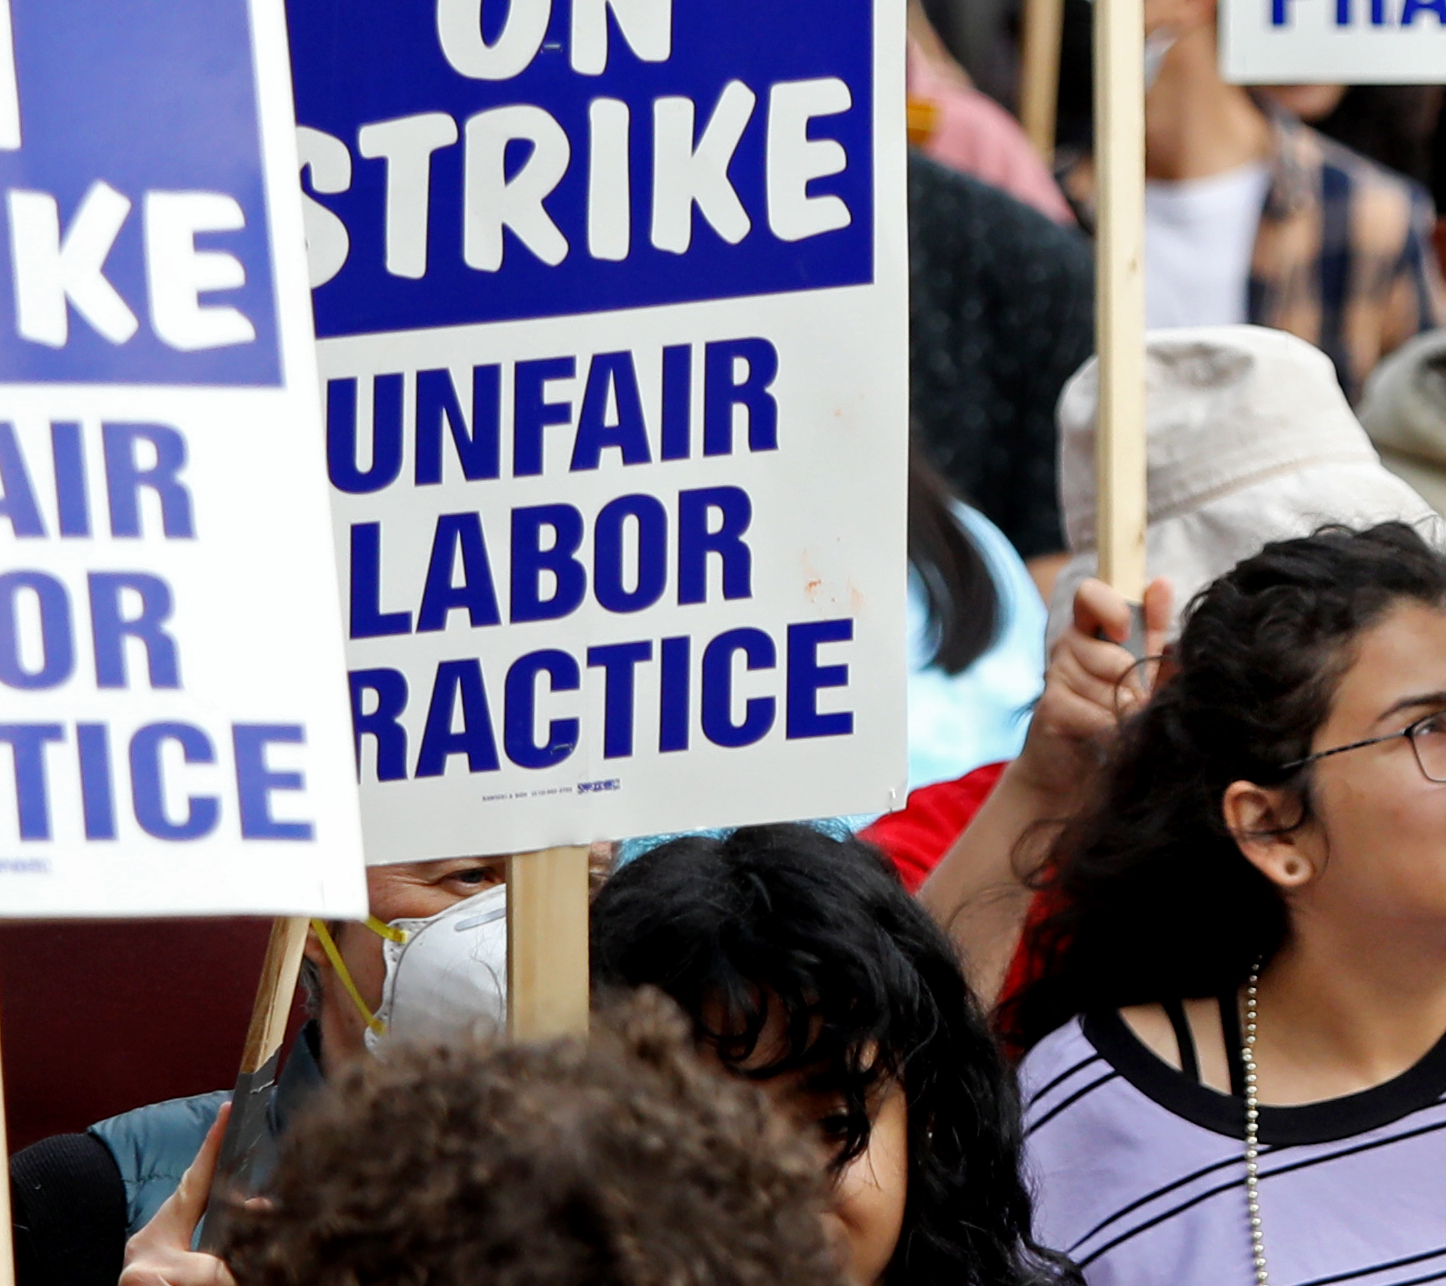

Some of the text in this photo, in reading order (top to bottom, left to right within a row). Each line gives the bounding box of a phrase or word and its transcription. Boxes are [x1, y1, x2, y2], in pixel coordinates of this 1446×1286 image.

[296, 75, 856, 293] STRIKE
[325, 335, 782, 497] UNFAIR
[348, 485, 756, 642] LABOR
[352, 618, 858, 785] RACTICE
